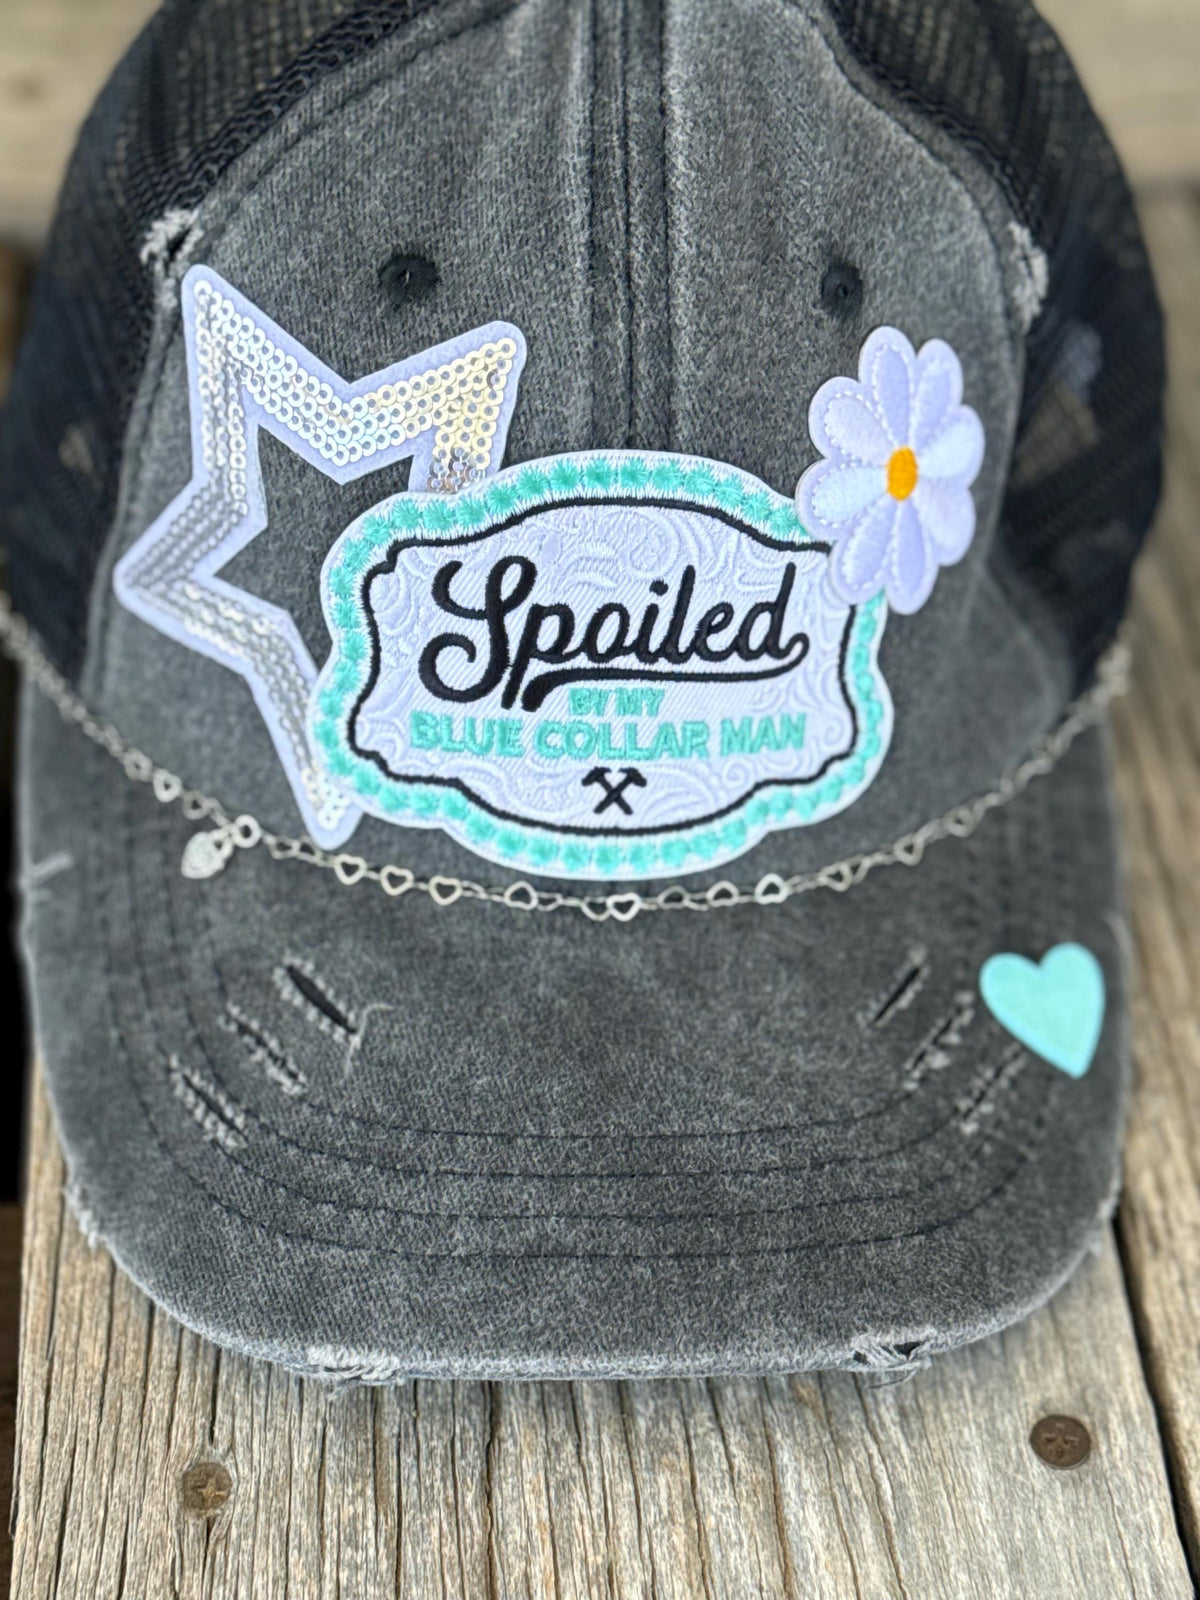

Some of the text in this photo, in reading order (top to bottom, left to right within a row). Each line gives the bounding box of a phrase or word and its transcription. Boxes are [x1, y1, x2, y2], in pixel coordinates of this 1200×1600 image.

[418, 554, 810, 712] Spoiled
[568, 687, 665, 717] BY MY
[409, 709, 807, 760] BLUE COLLAR MAN
